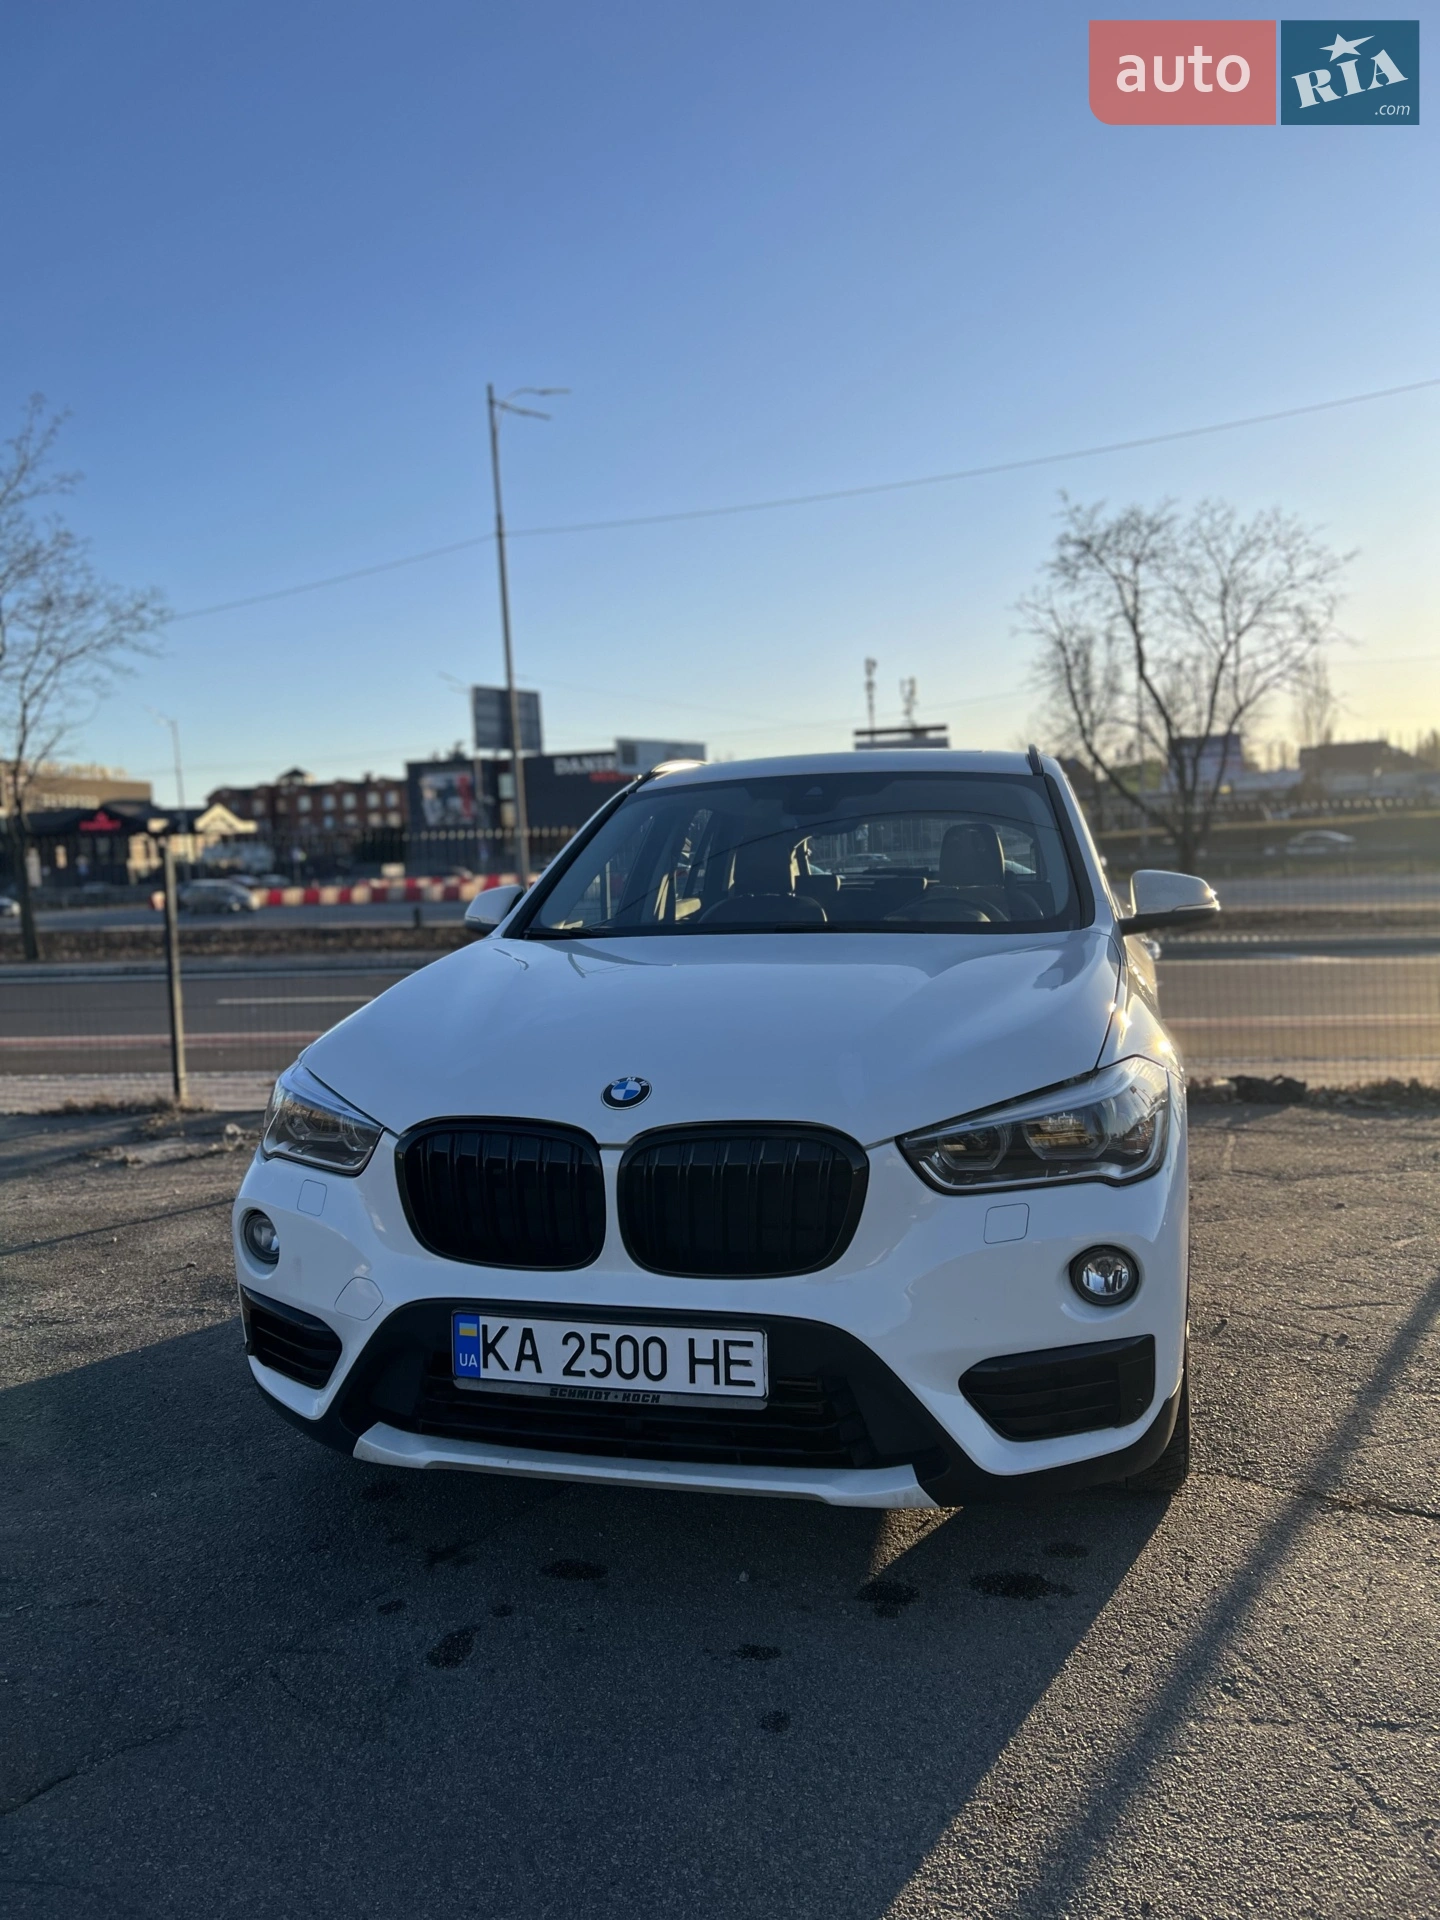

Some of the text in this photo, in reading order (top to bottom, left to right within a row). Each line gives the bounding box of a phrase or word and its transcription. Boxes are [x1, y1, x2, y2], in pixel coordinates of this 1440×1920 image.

[459, 1352, 478, 1368] UA
[481, 1324, 756, 1387] KA 2500 HE
[549, 1387, 611, 1401] SCHMIDT
[621, 1392, 661, 1404] KOCH
